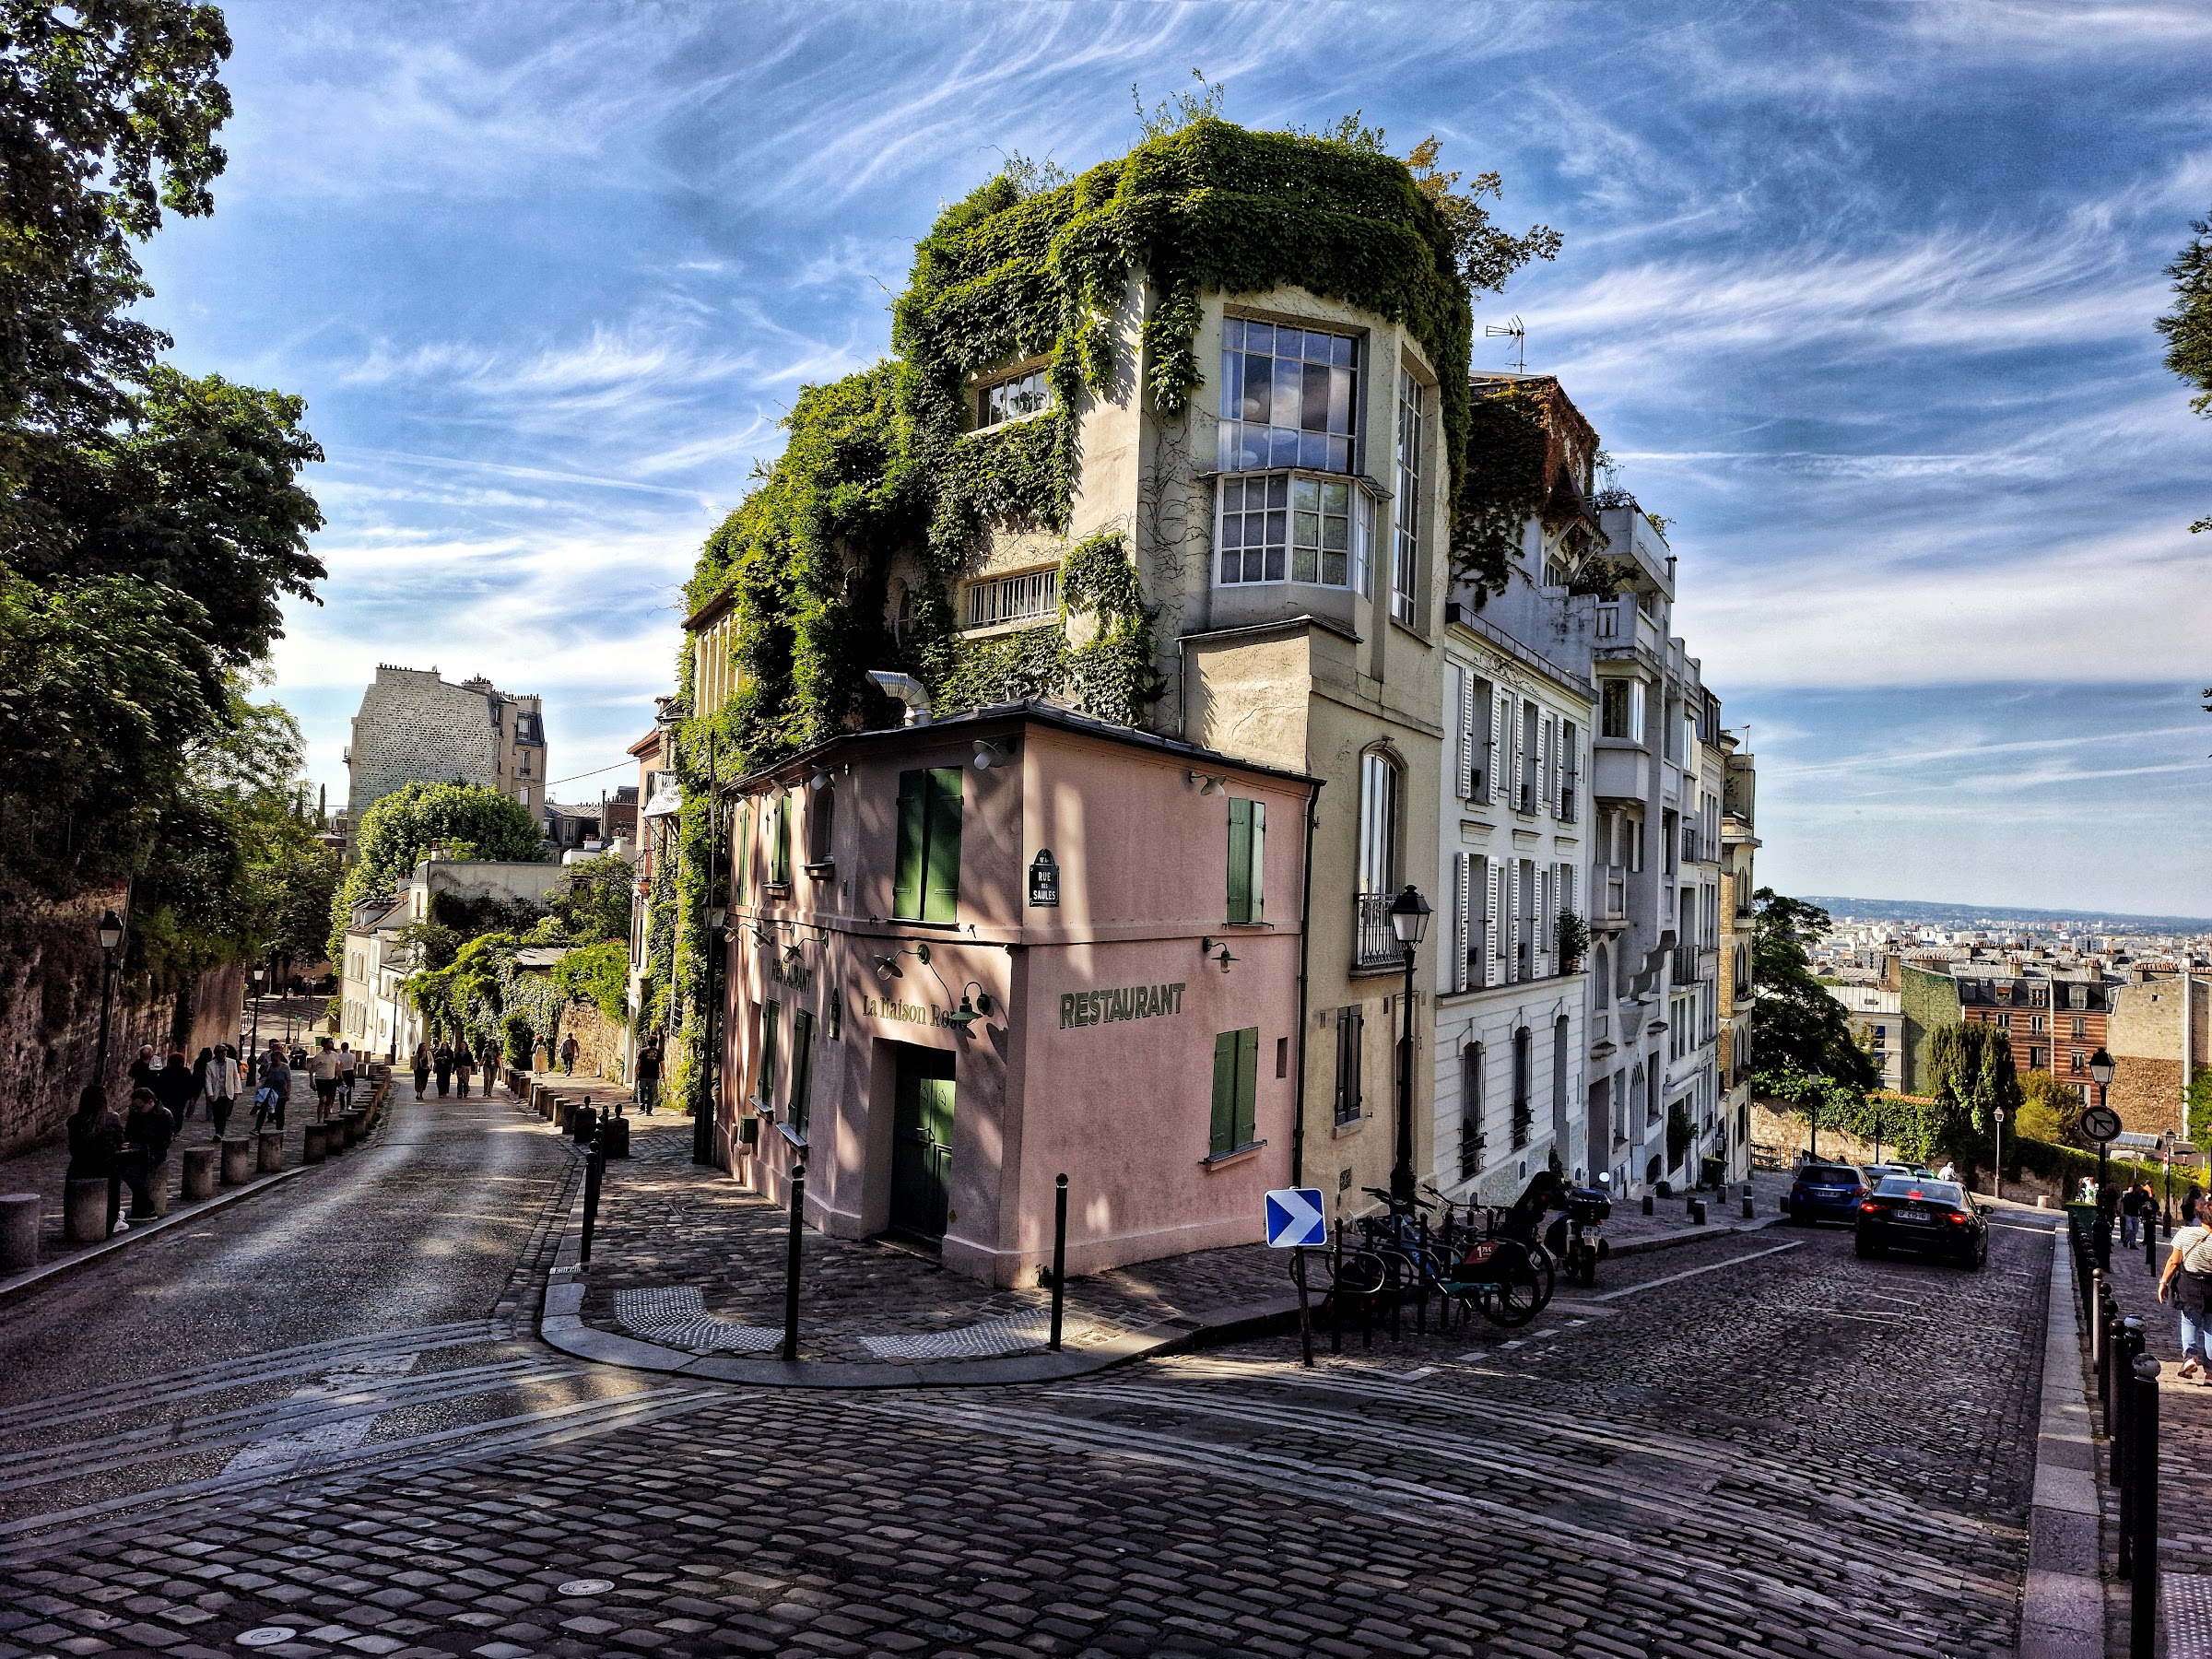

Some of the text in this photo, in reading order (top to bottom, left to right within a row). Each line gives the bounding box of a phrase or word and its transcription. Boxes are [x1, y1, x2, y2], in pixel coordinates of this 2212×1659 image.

[1038, 871, 1052, 882] RUE
[1033, 889, 1056, 900] SAULES
[863, 994, 877, 1018] La
[879, 996, 927, 1026] Maison
[1060, 982, 1186, 1030] RESTAURANT
